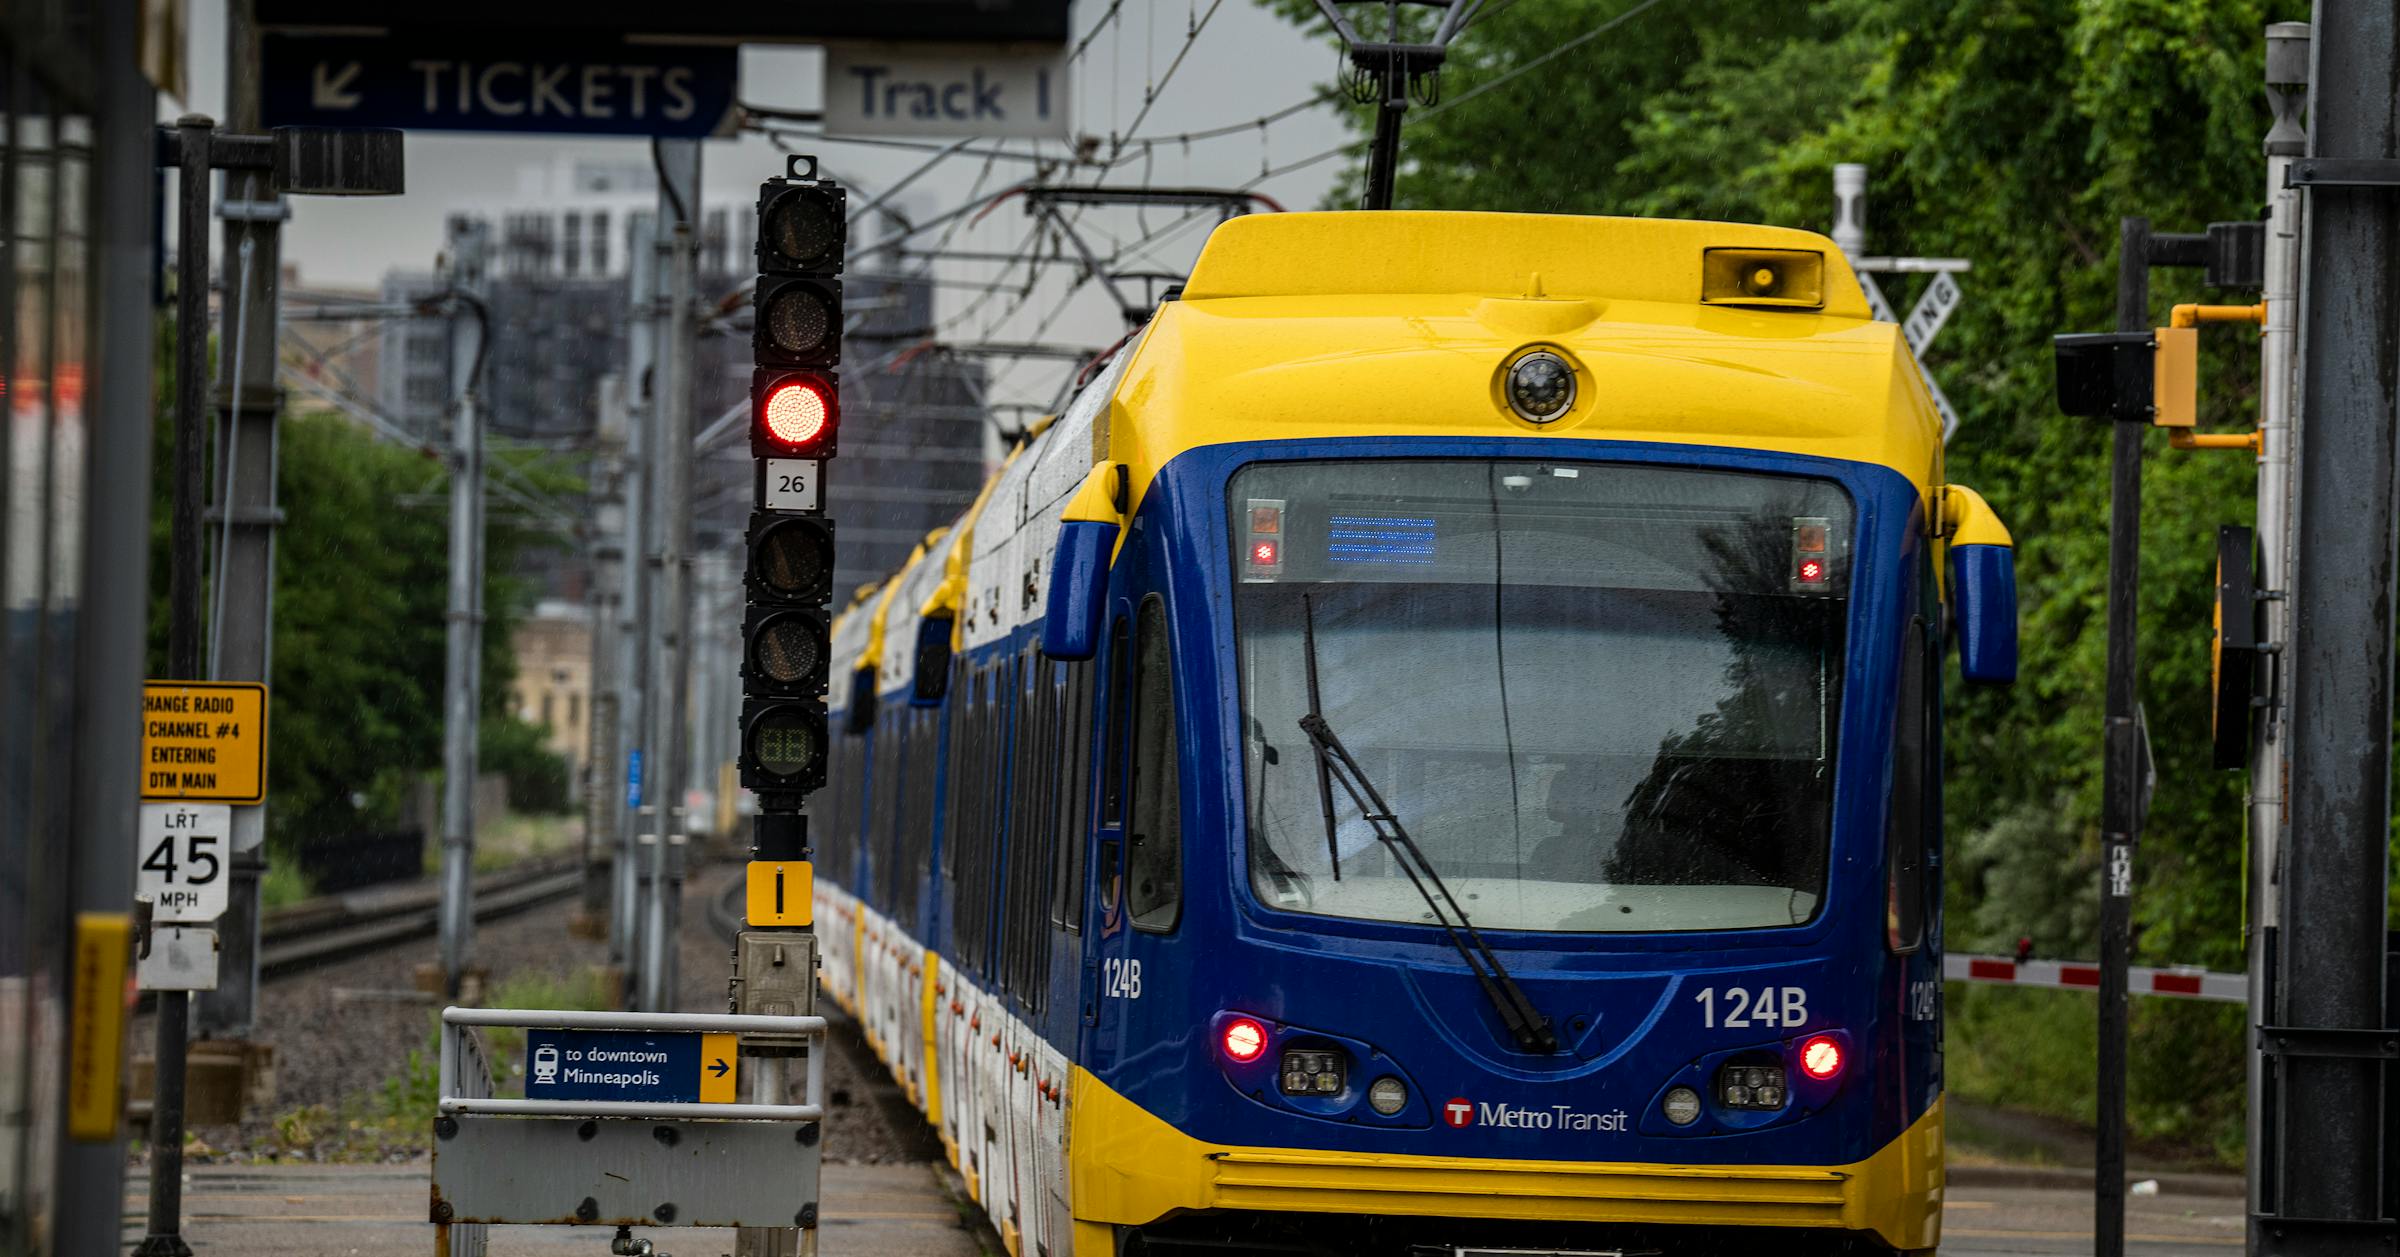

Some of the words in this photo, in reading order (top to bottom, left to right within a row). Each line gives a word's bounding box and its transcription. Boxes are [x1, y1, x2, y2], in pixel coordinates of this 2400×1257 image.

[410, 60, 696, 121] TICKETS
[849, 65, 1004, 121] Track
[778, 475, 805, 493] 26
[194, 697, 234, 714] RADIO
[149, 720, 211, 739] CHANNEL
[216, 722, 240, 740] #4
[151, 746, 217, 764] ENTERING
[149, 772, 177, 789] DTM
[181, 772, 217, 790] MAIN
[165, 813, 199, 829] LRT
[141, 835, 220, 886] 45
[159, 892, 199, 908] MPH
[1103, 957, 1142, 999] 124B
[1694, 986, 1809, 1028] 124B
[566, 1049, 583, 1062] to
[587, 1047, 668, 1064] downtown
[563, 1067, 661, 1089] Minneapolis
